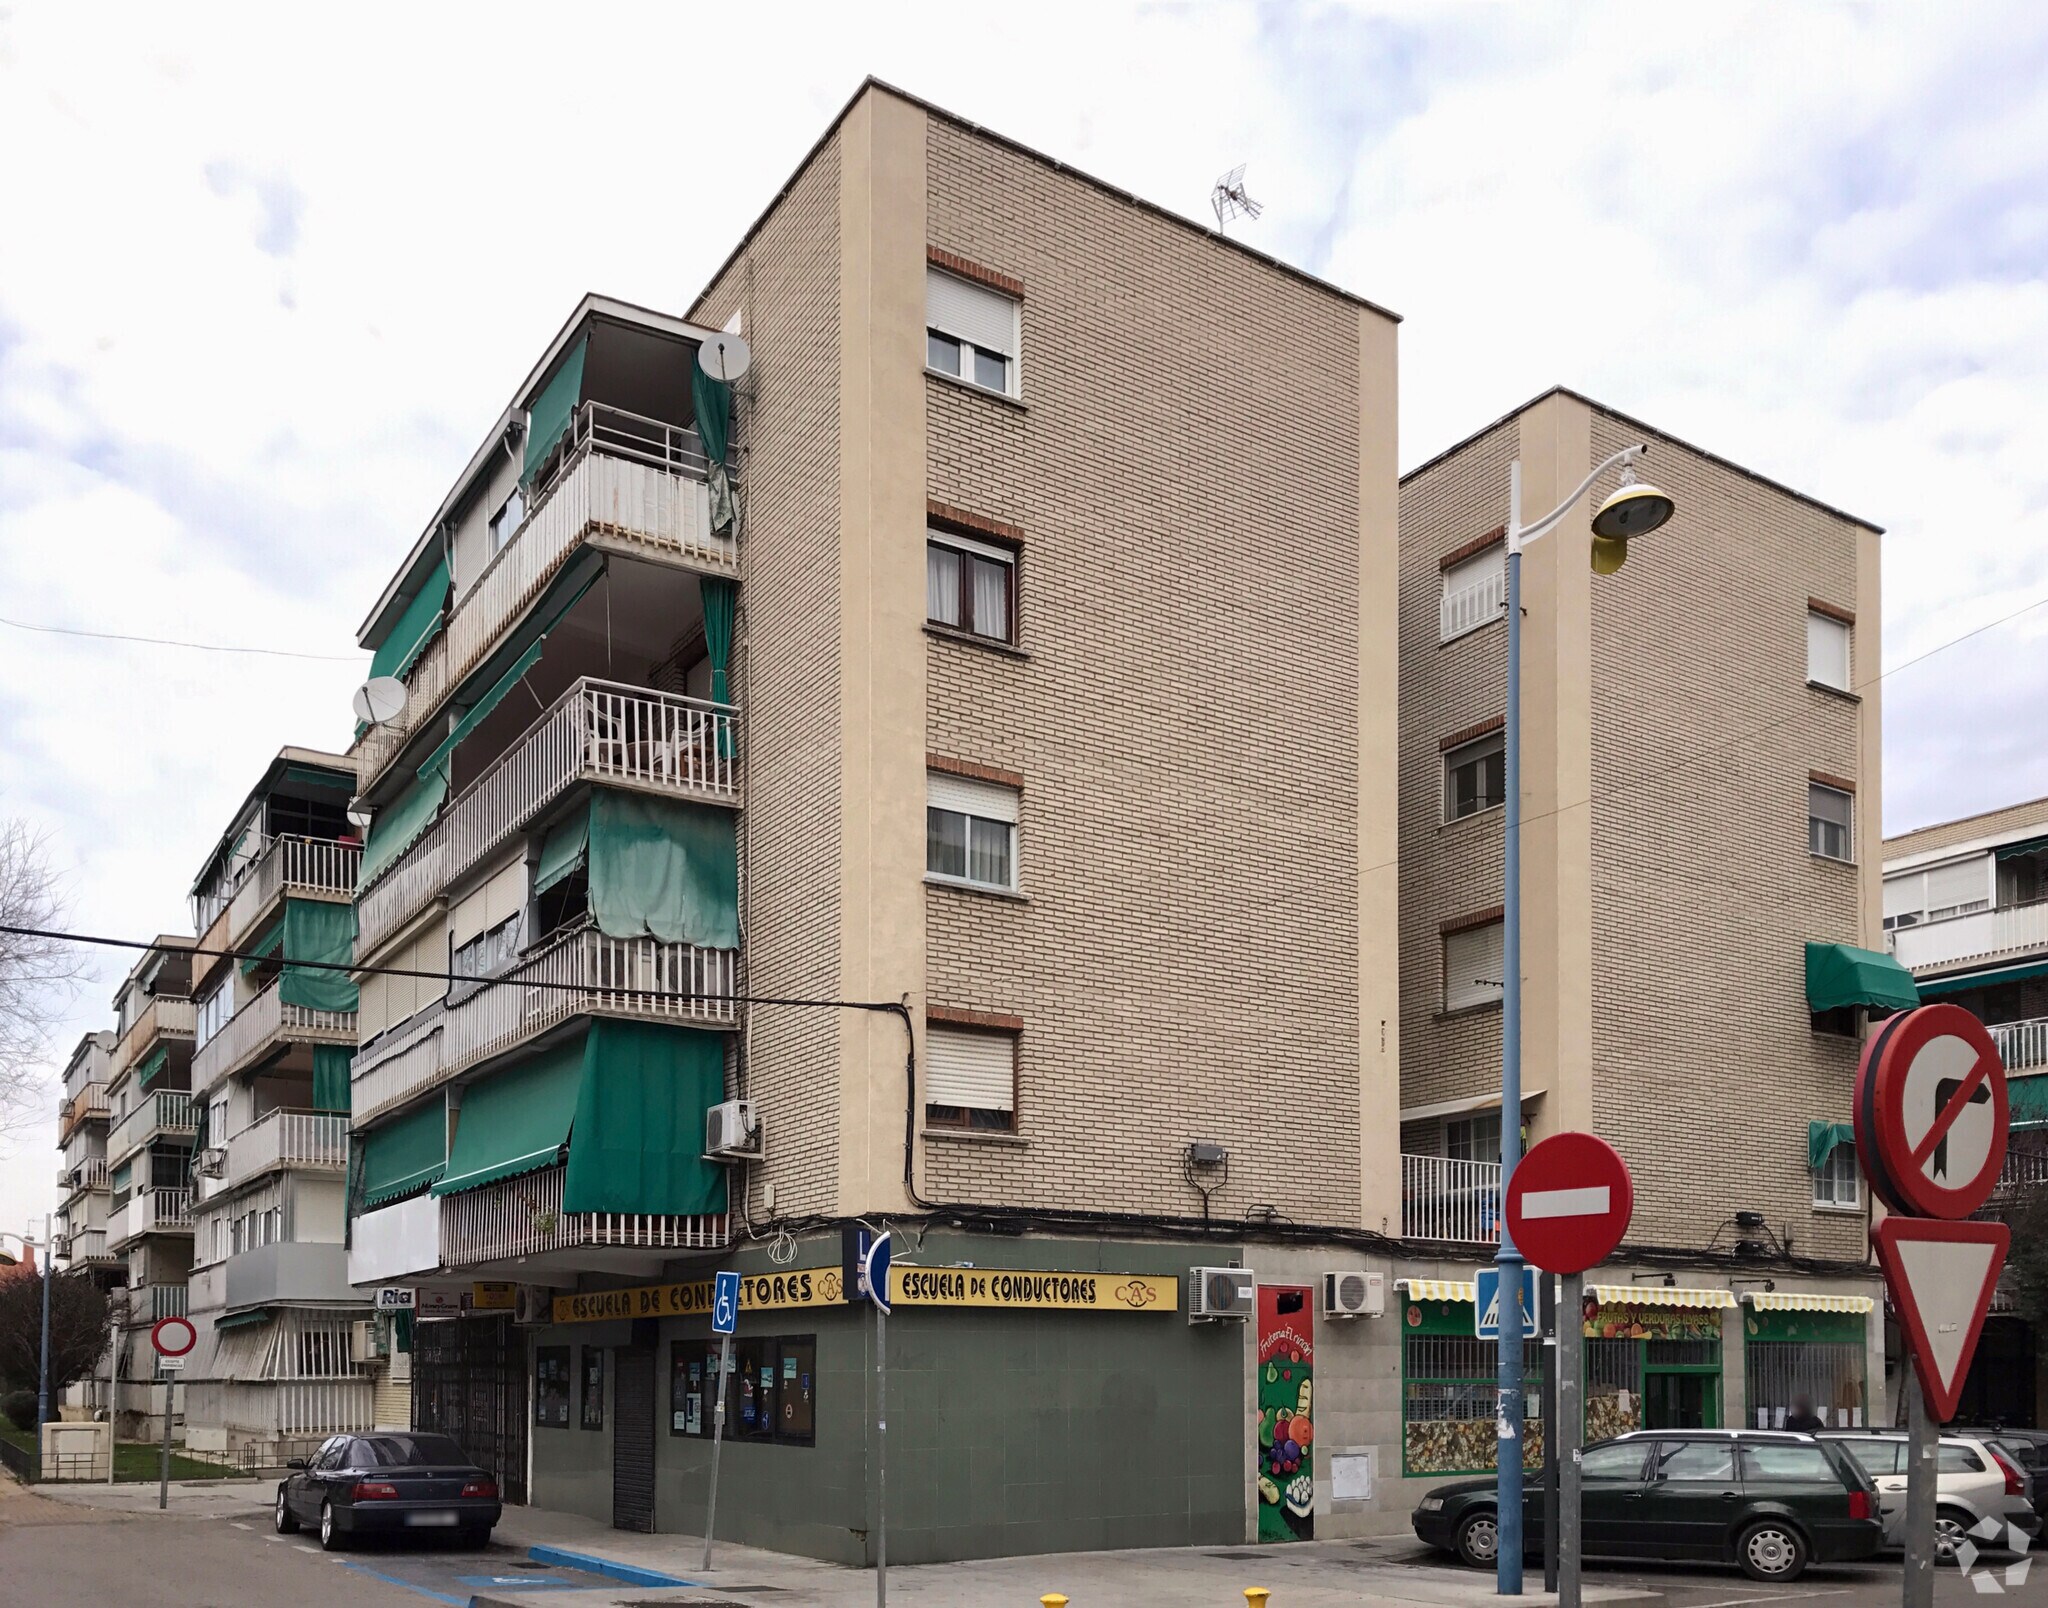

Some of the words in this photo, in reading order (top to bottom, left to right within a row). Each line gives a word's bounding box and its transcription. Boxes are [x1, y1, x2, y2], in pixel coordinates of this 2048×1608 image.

[382, 1289, 412, 1304] Ria
[572, 1291, 632, 1318] ESCUELA
[640, 1289, 660, 1313] DE
[670, 1274, 812, 1311] CONDTORES
[902, 1272, 965, 1300] ESCUELA
[970, 1277, 986, 1298] DE
[991, 1275, 1097, 1304] CONDUCTORES
[1114, 1285, 1157, 1303] CAS
[1597, 1311, 1629, 1324] FRUTAS
[1631, 1311, 1637, 1324] Y
[1639, 1312, 1681, 1325] VERDURAS
